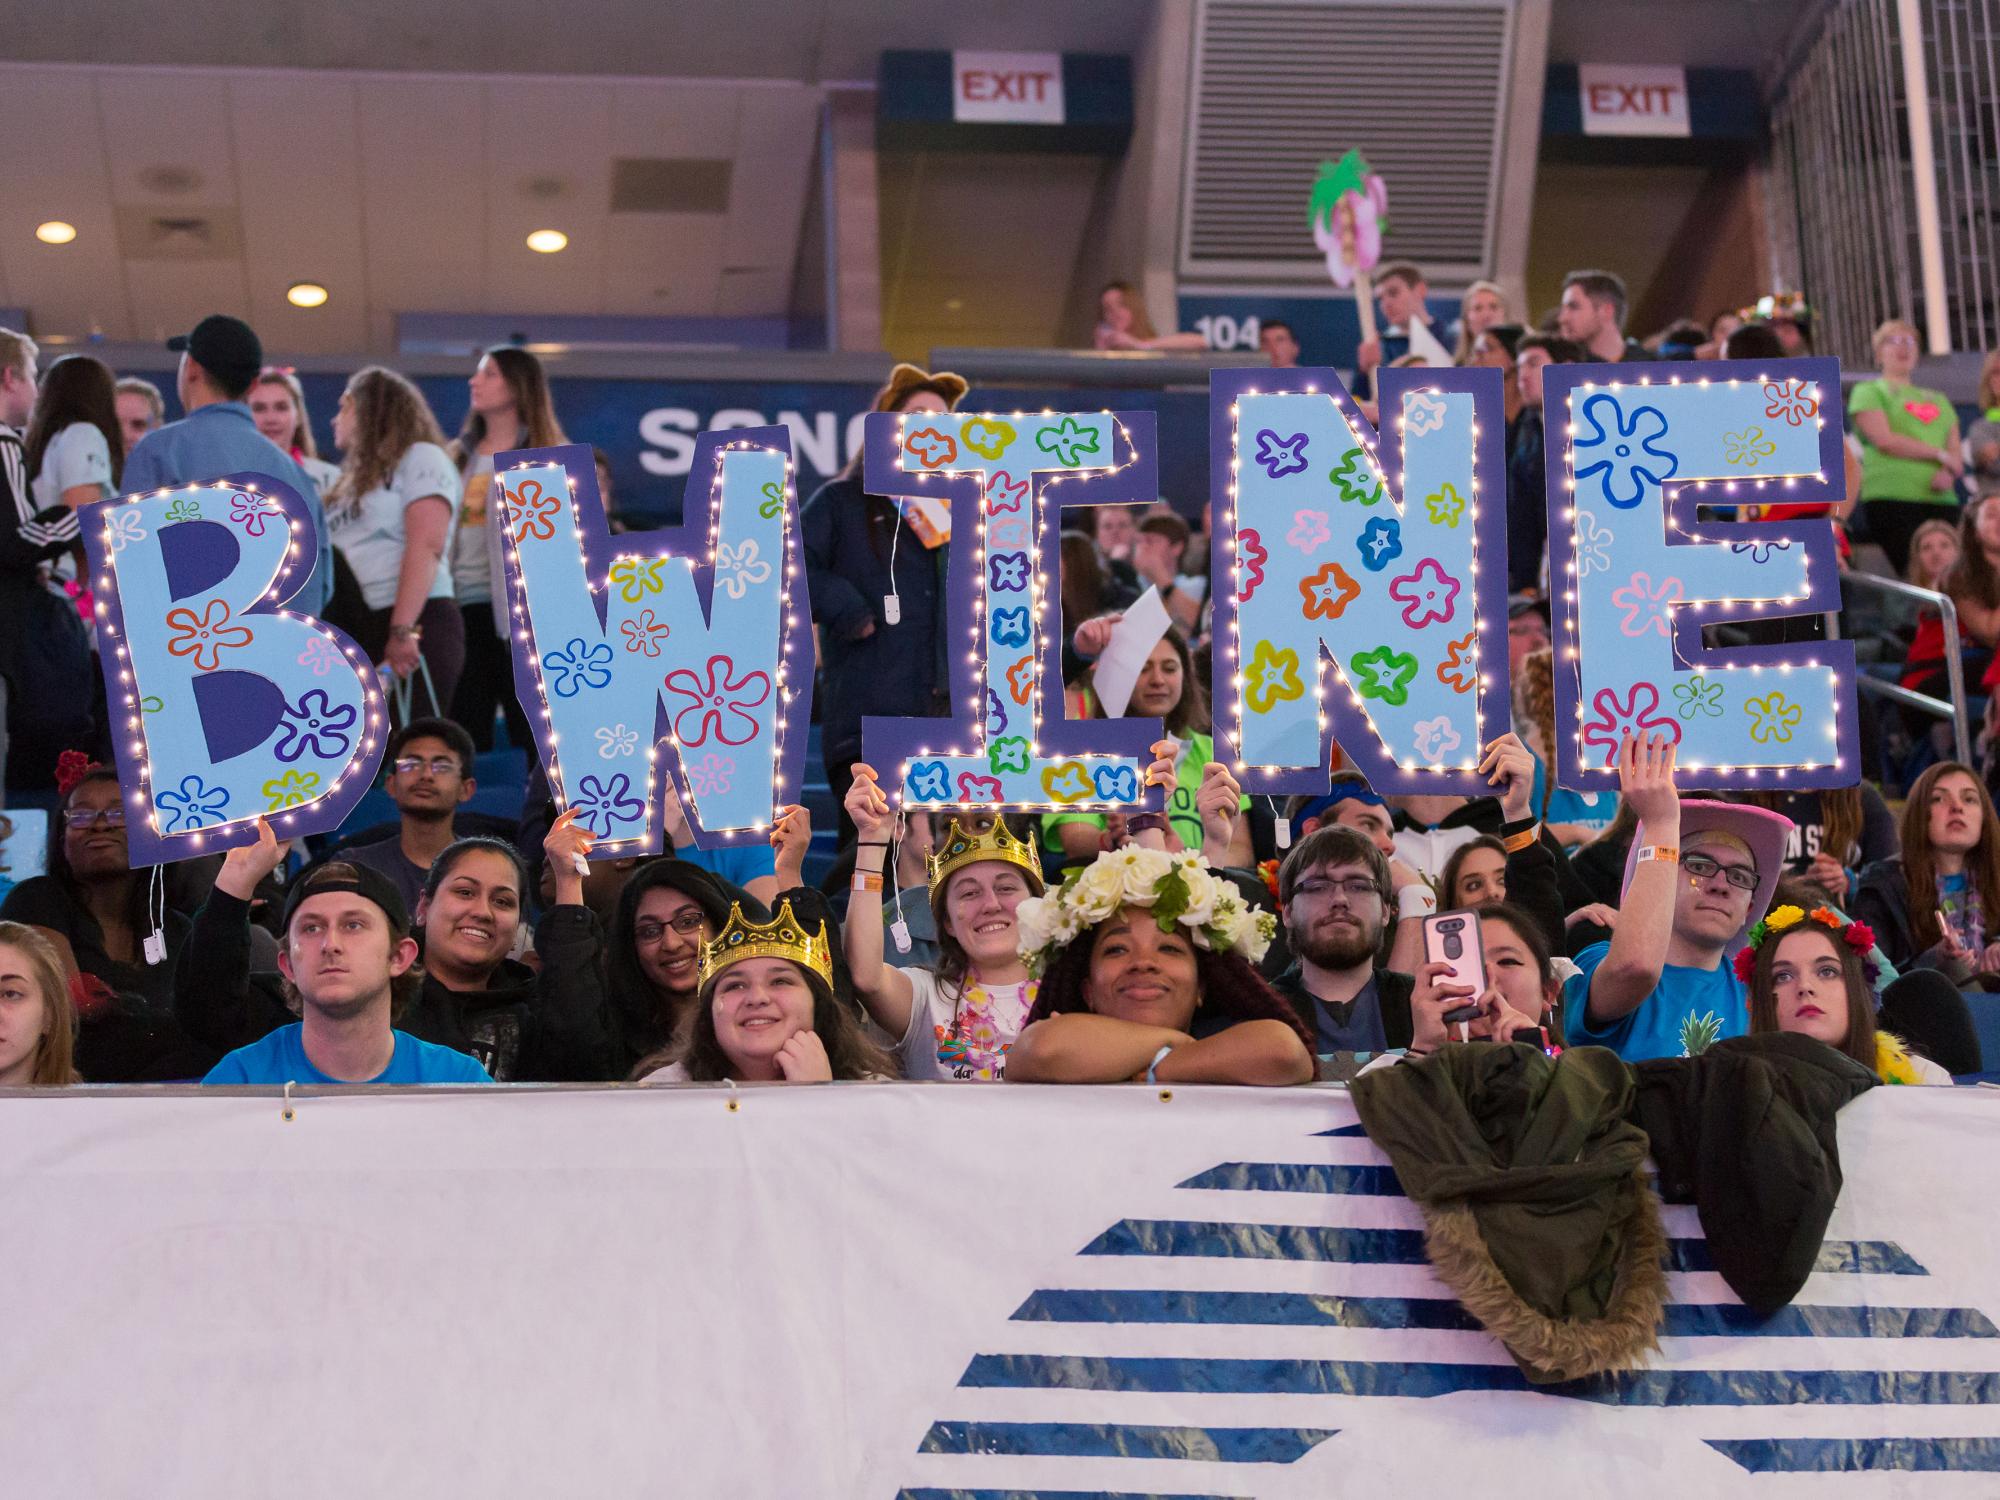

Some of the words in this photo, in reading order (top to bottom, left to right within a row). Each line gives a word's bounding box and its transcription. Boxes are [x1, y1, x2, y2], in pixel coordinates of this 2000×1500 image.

[962, 70, 1052, 102] EXIT
[1588, 84, 1677, 115] EXIT
[1194, 314, 1260, 350] 104
